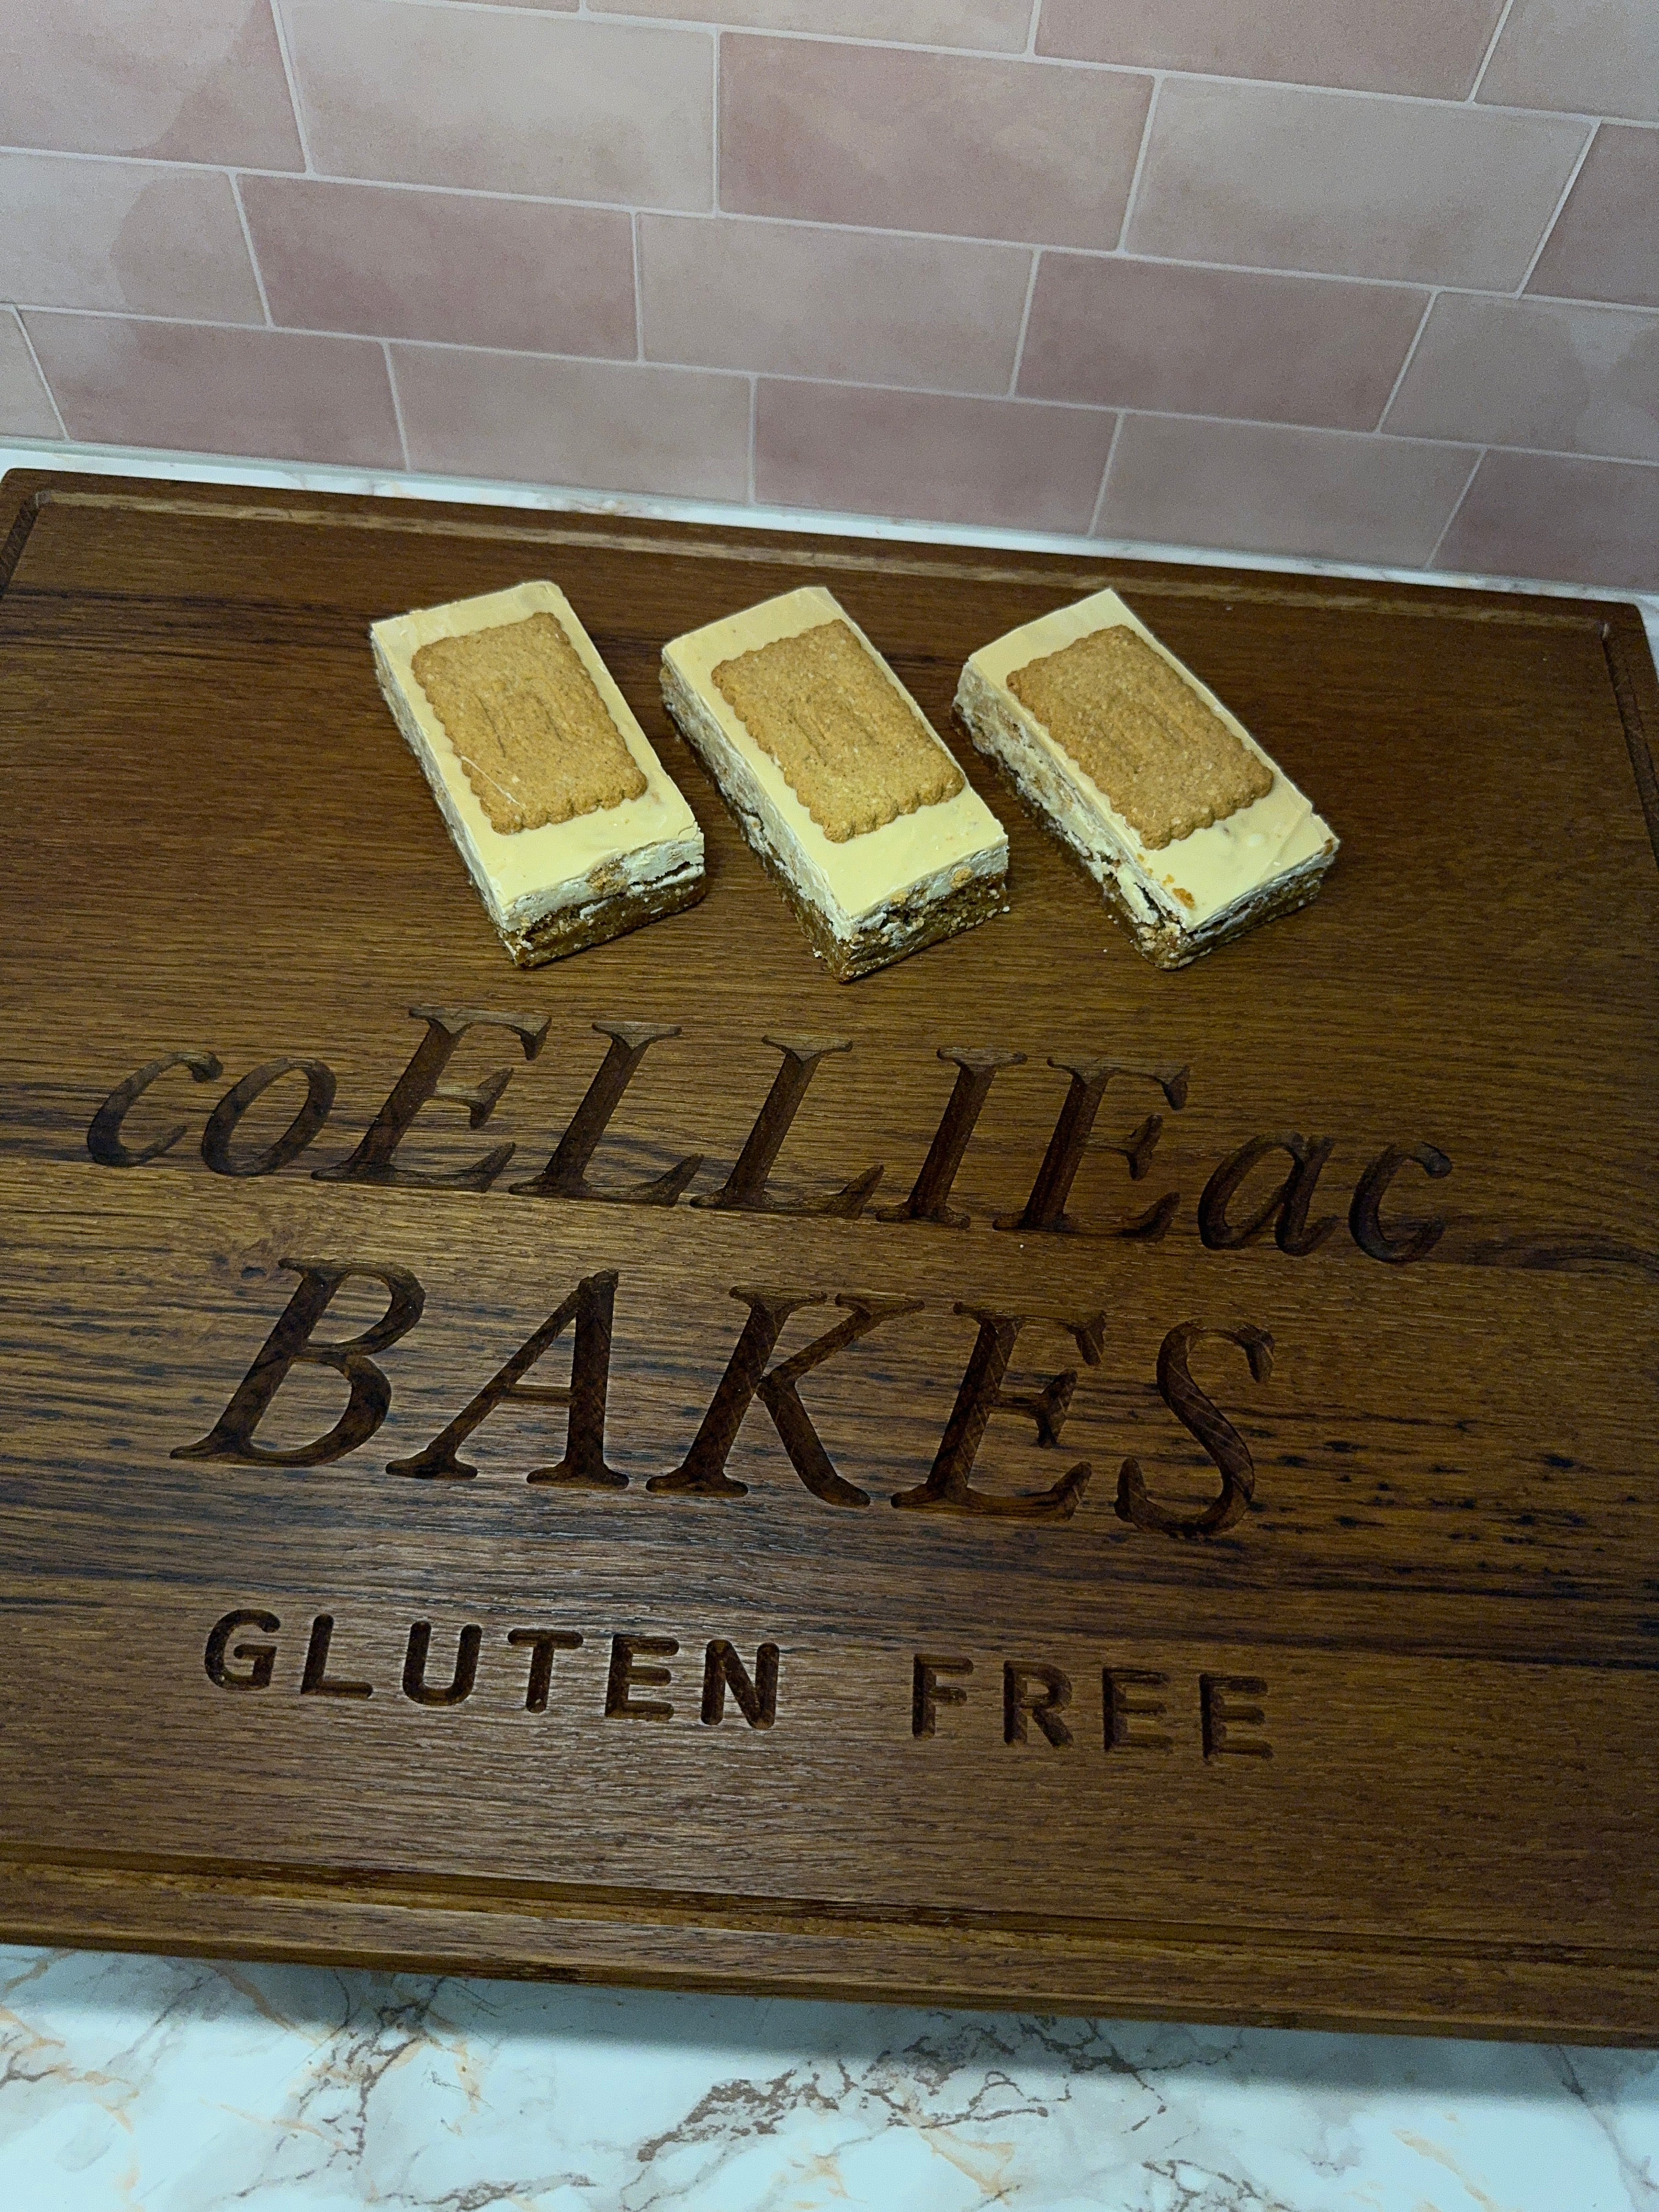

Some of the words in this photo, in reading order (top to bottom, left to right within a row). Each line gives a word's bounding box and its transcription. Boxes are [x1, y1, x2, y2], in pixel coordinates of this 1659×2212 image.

[86, 1006, 1453, 1264] coELLIEac
[169, 1256, 1277, 1542] BAKES
[204, 1609, 781, 1731] GLUTEN
[912, 1653, 1274, 1762] FREE
